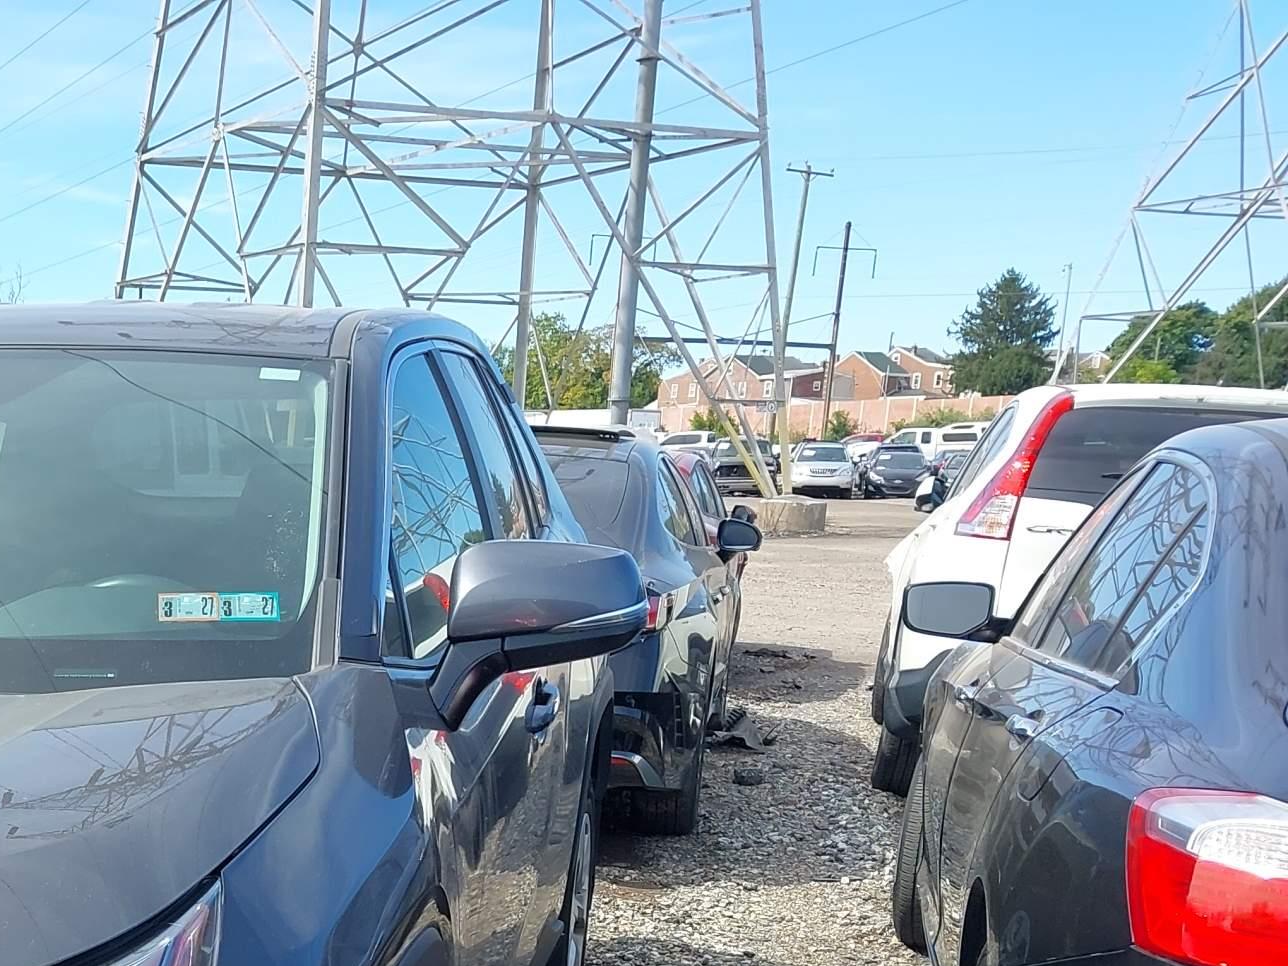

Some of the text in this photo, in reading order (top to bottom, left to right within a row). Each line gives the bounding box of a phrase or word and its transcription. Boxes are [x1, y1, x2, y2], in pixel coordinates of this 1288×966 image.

[163, 596, 214, 618] 3 27
[222, 596, 274, 617] 3 27
